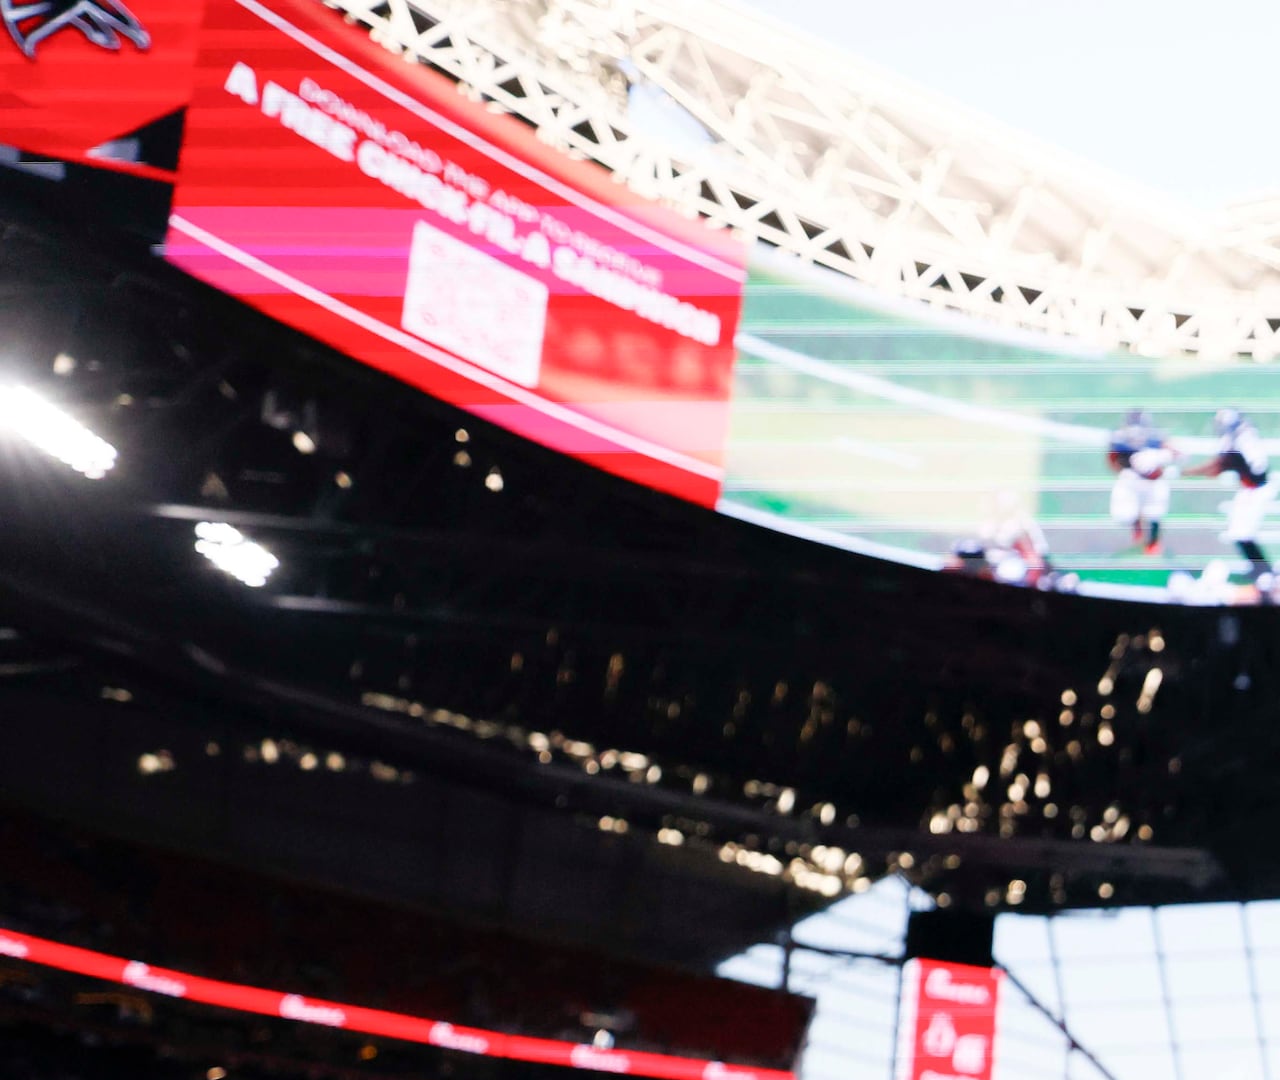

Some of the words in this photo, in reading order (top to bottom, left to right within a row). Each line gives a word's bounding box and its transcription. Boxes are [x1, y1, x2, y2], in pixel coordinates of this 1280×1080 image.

[224, 61, 258, 105] A
[261, 80, 357, 162] FREE
[299, 77, 443, 173] DOWNLOAD
